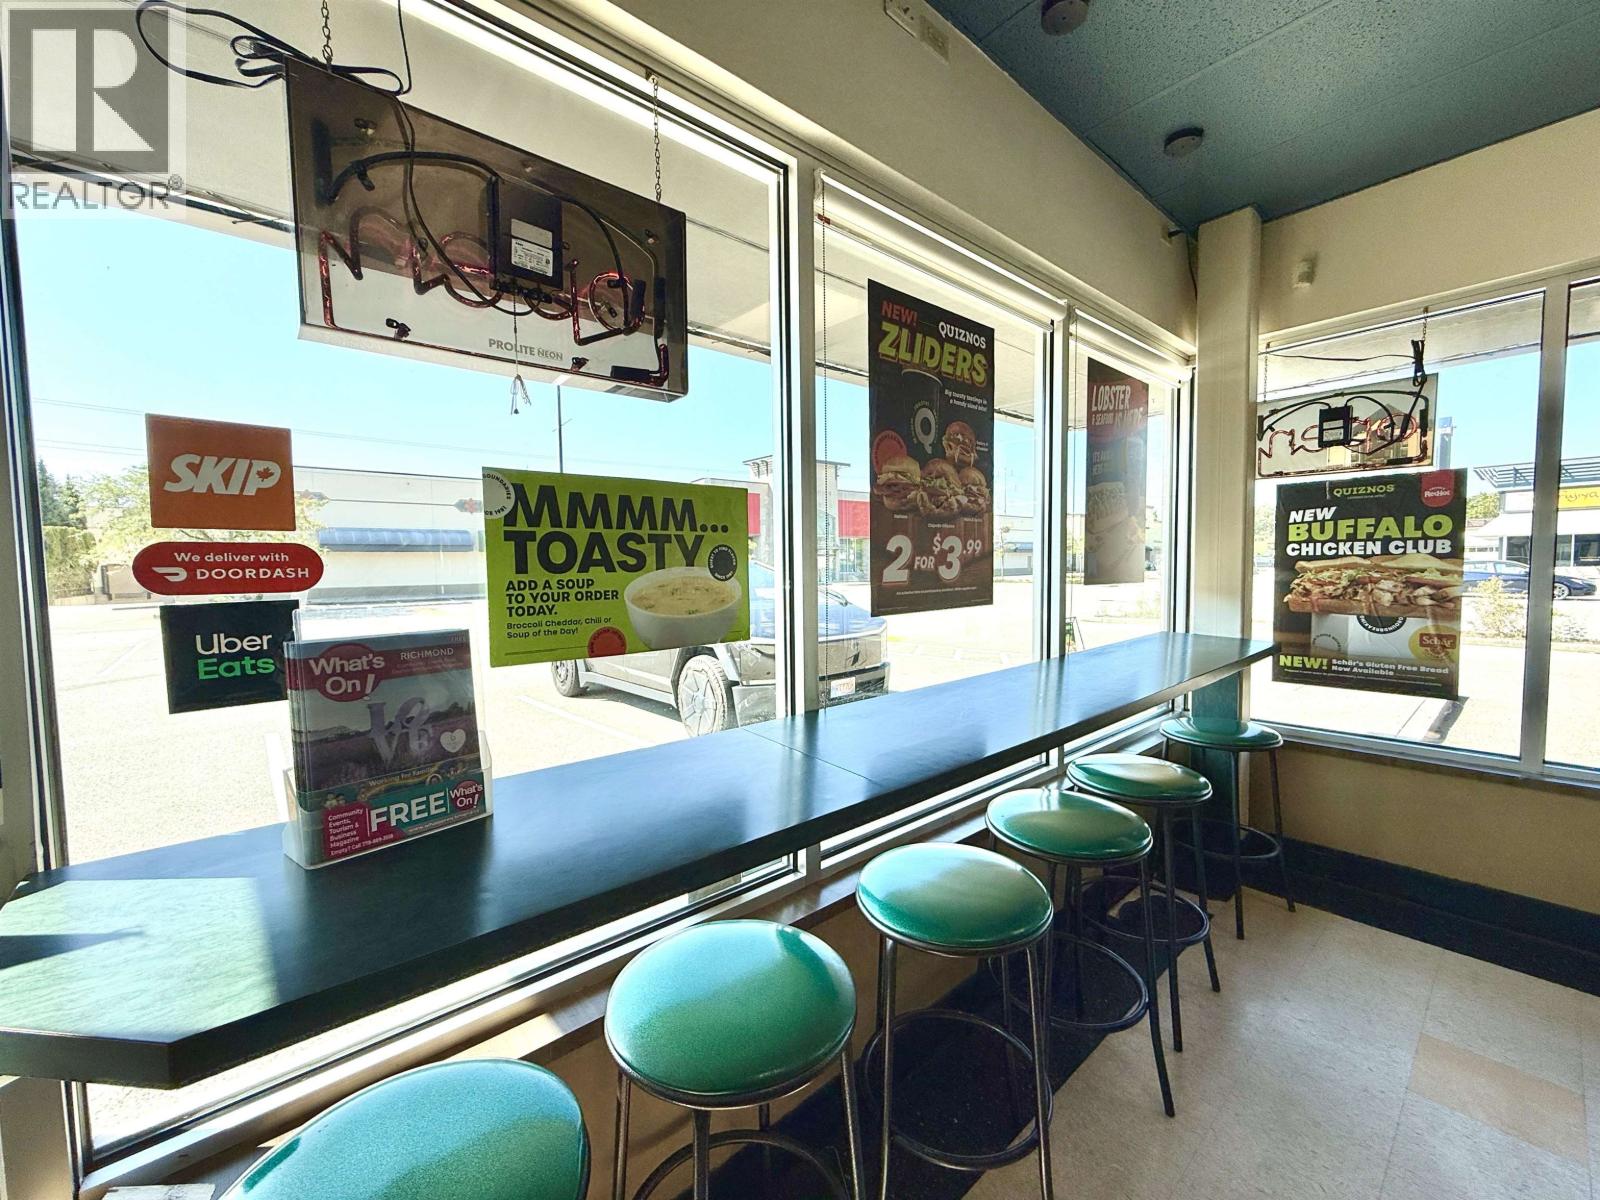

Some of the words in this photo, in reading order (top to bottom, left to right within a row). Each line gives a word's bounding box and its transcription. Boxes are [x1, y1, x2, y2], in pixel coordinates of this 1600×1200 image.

[881, 300, 918, 327] NEW!
[938, 321, 987, 349] QUIZNOS
[488, 337, 536, 356] PROLITE
[537, 347, 563, 361] NEON
[878, 321, 988, 386] ZLIDERS
[1091, 384, 1131, 412] LOBSTER
[163, 453, 282, 496] SKIP
[1333, 483, 1395, 498] QUIZNOS
[1288, 506, 1337, 524] NEW
[1287, 514, 1454, 542] BUFFALO
[503, 530, 705, 575] TOASTY
[1286, 539, 1382, 557] CHICKEN
[1388, 539, 1452, 554] CLUB
[174, 552, 201, 562] We
[204, 552, 255, 563] deliver
[258, 552, 289, 562] with
[882, 534, 913, 583] 2
[914, 556, 936, 570] FOR
[196, 567, 310, 580] DOORDASH
[505, 579, 538, 593] ADD
[542, 579, 553, 591] A
[556, 578, 595, 590] SOUP
[506, 592, 526, 605] TO
[528, 591, 571, 603] YOUR
[574, 589, 619, 601] ORDER
[506, 604, 558, 618] TODAY.
[507, 619, 543, 630] Broccoli
[545, 617, 583, 628] Cheddar,
[585, 616, 602, 625] Chili
[603, 616, 612, 624] or
[507, 629, 530, 639] Soup
[532, 628, 541, 637] of
[543, 628, 558, 636] the
[560, 626, 579, 637] Day!
[195, 632, 273, 656] Uber
[400, 647, 455, 661] RICHMOND
[1279, 654, 1328, 670] NEW!
[197, 656, 276, 681] Eats
[308, 653, 386, 676] What's
[1352, 666, 1395, 676] Available
[1365, 661, 1396, 670] Gluten
[1397, 663, 1418, 672] Free
[1419, 665, 1449, 674] Bread
[325, 673, 376, 700] On!
[449, 783, 484, 804] What's
[456, 793, 480, 809] On!
[327, 807, 364, 822] Community
[369, 791, 447, 833] FREE
[328, 824, 354, 835] Tourism
[329, 830, 357, 842] Business
